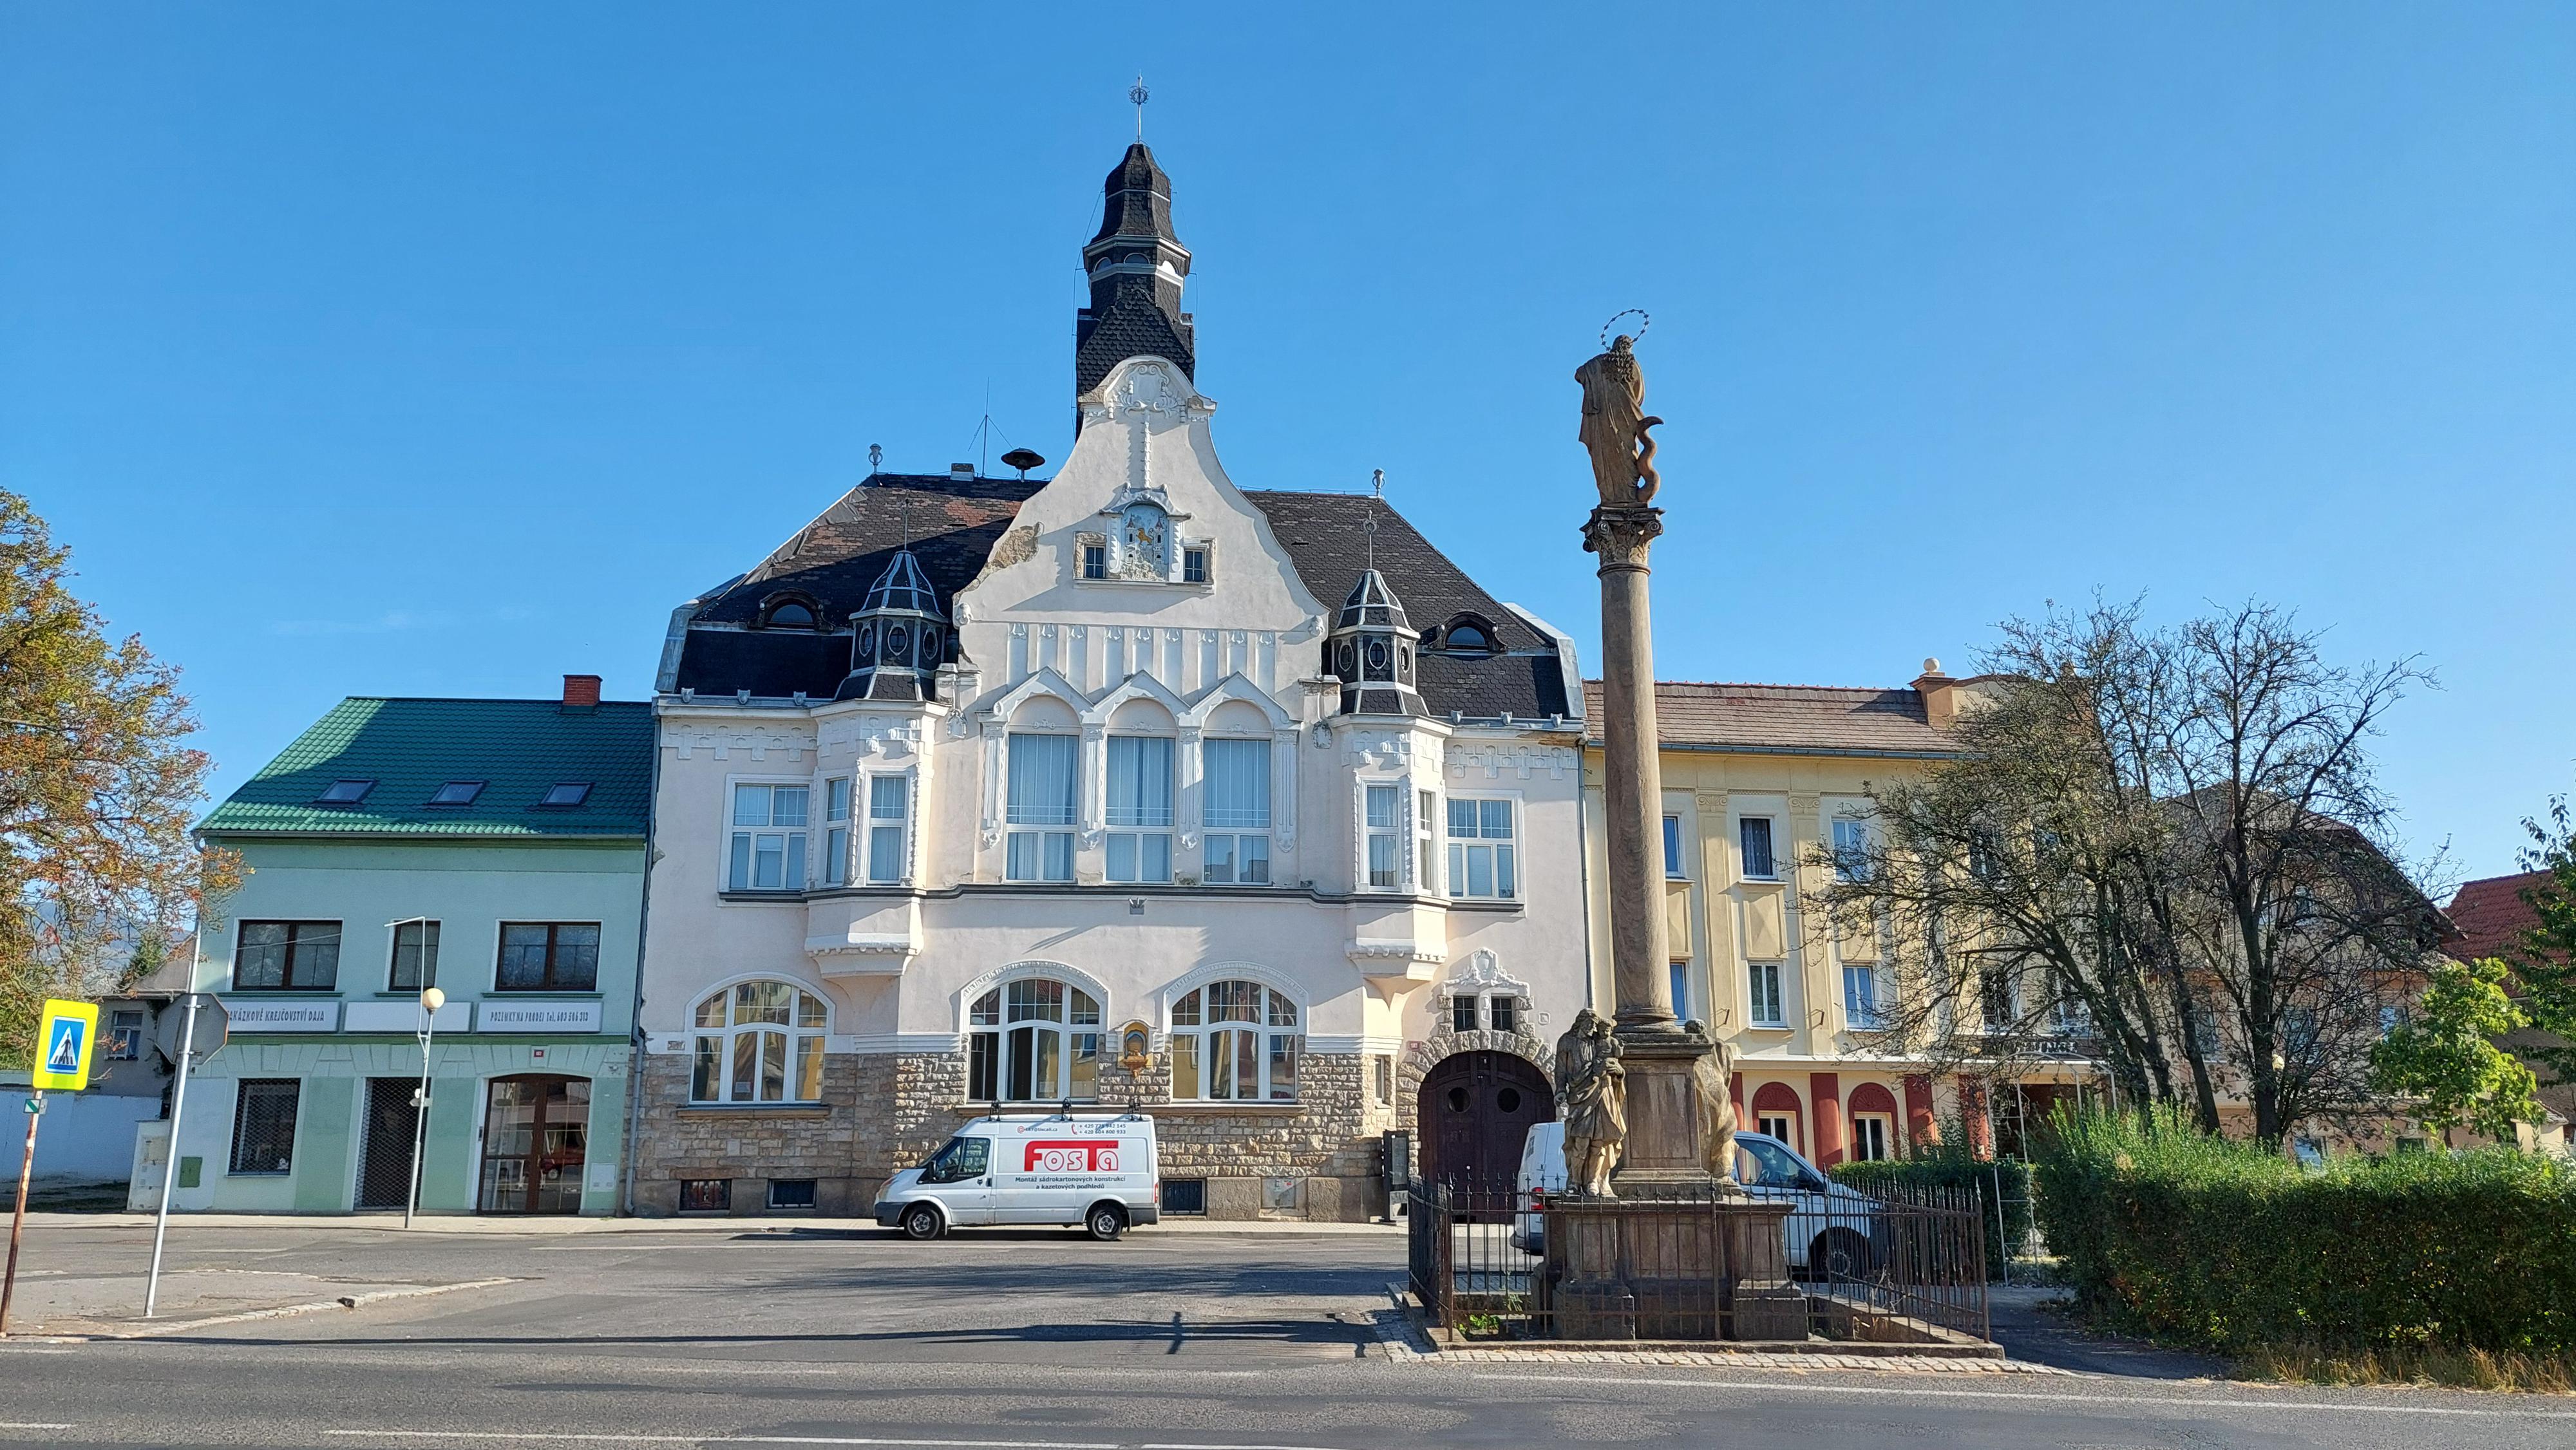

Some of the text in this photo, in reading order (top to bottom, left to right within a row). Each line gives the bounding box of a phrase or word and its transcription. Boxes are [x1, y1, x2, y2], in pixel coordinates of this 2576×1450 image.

[227, 1008, 325, 1021] AKÁZKOVÉ KREJČOVSTVÍ DAJA
